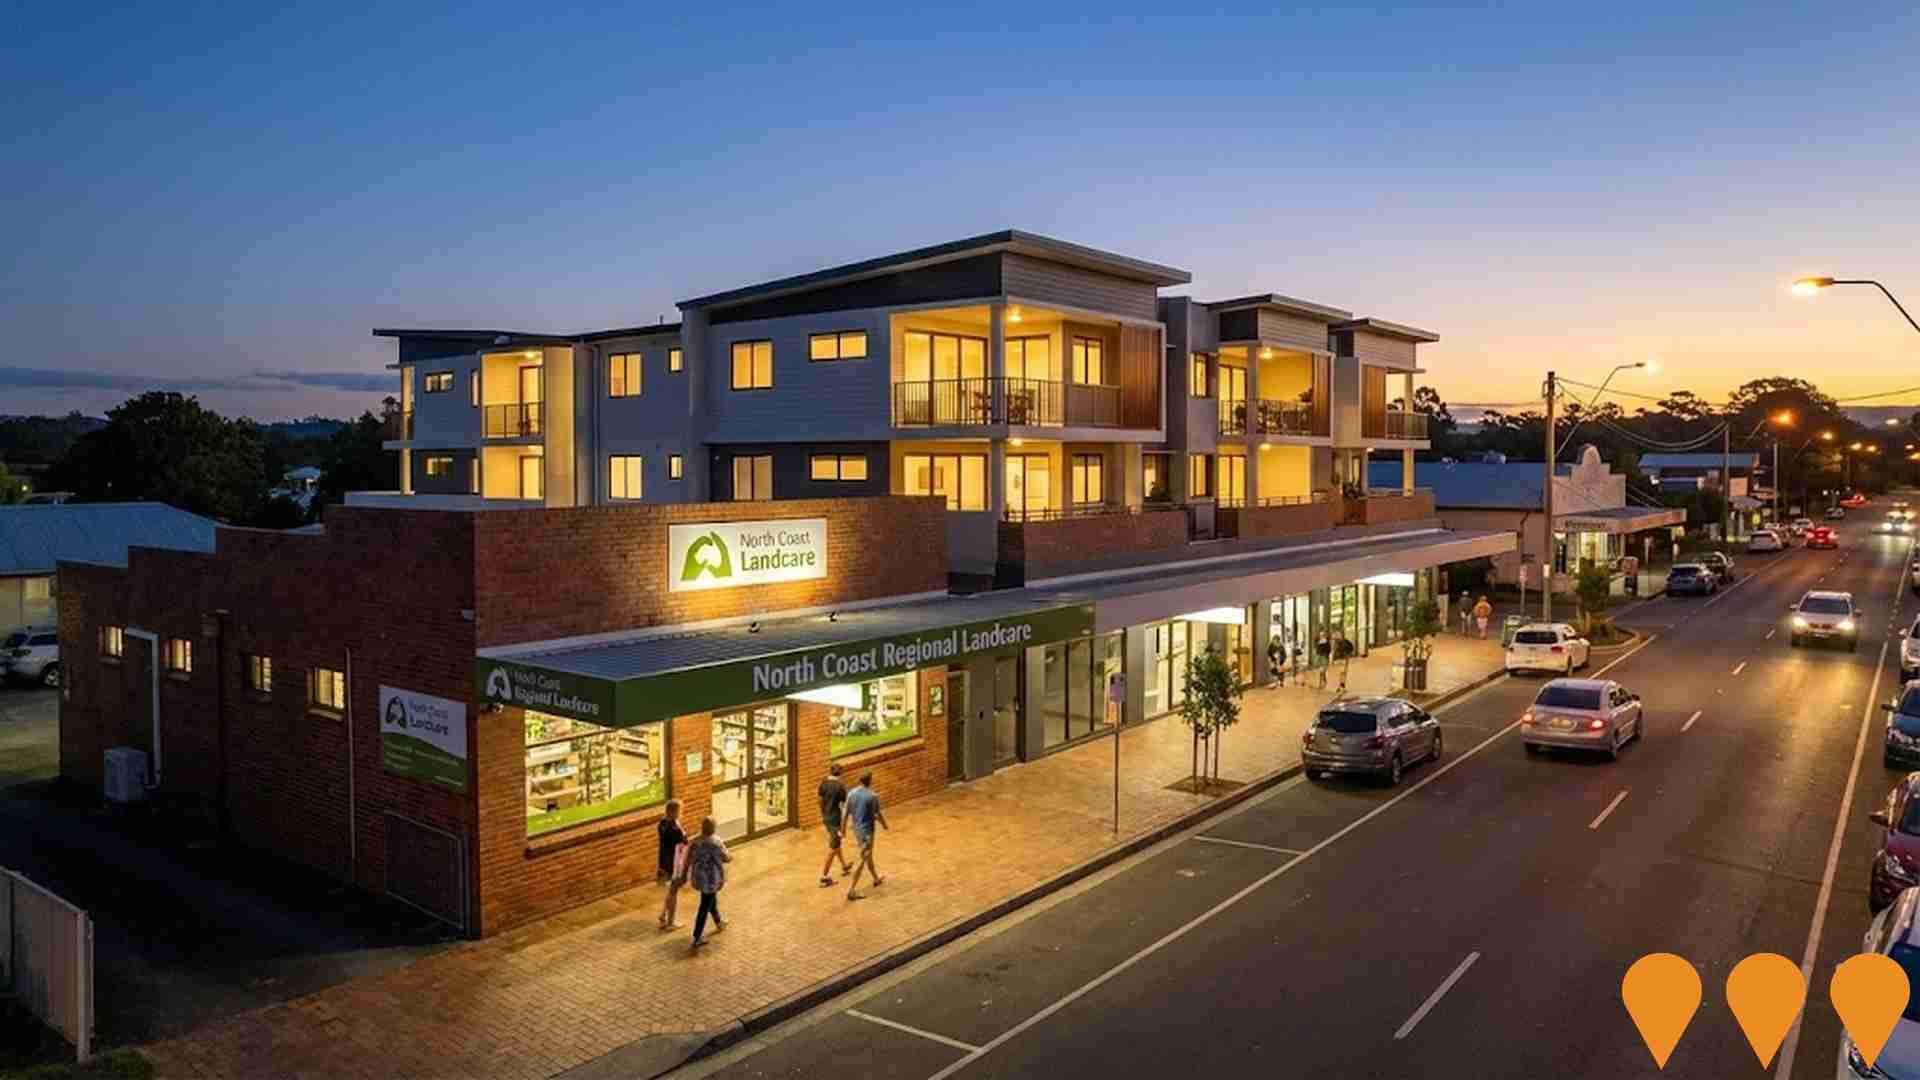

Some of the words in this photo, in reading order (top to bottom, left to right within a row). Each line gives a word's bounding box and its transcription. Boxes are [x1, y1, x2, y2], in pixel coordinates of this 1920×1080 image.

[739, 531, 775, 548] North
[777, 530, 811, 546] Coast
[741, 549, 816, 572] Landcare
[752, 655, 816, 693] North
[822, 647, 878, 678] Coast
[883, 630, 957, 670] Regional
[962, 623, 1032, 653] Landcare
